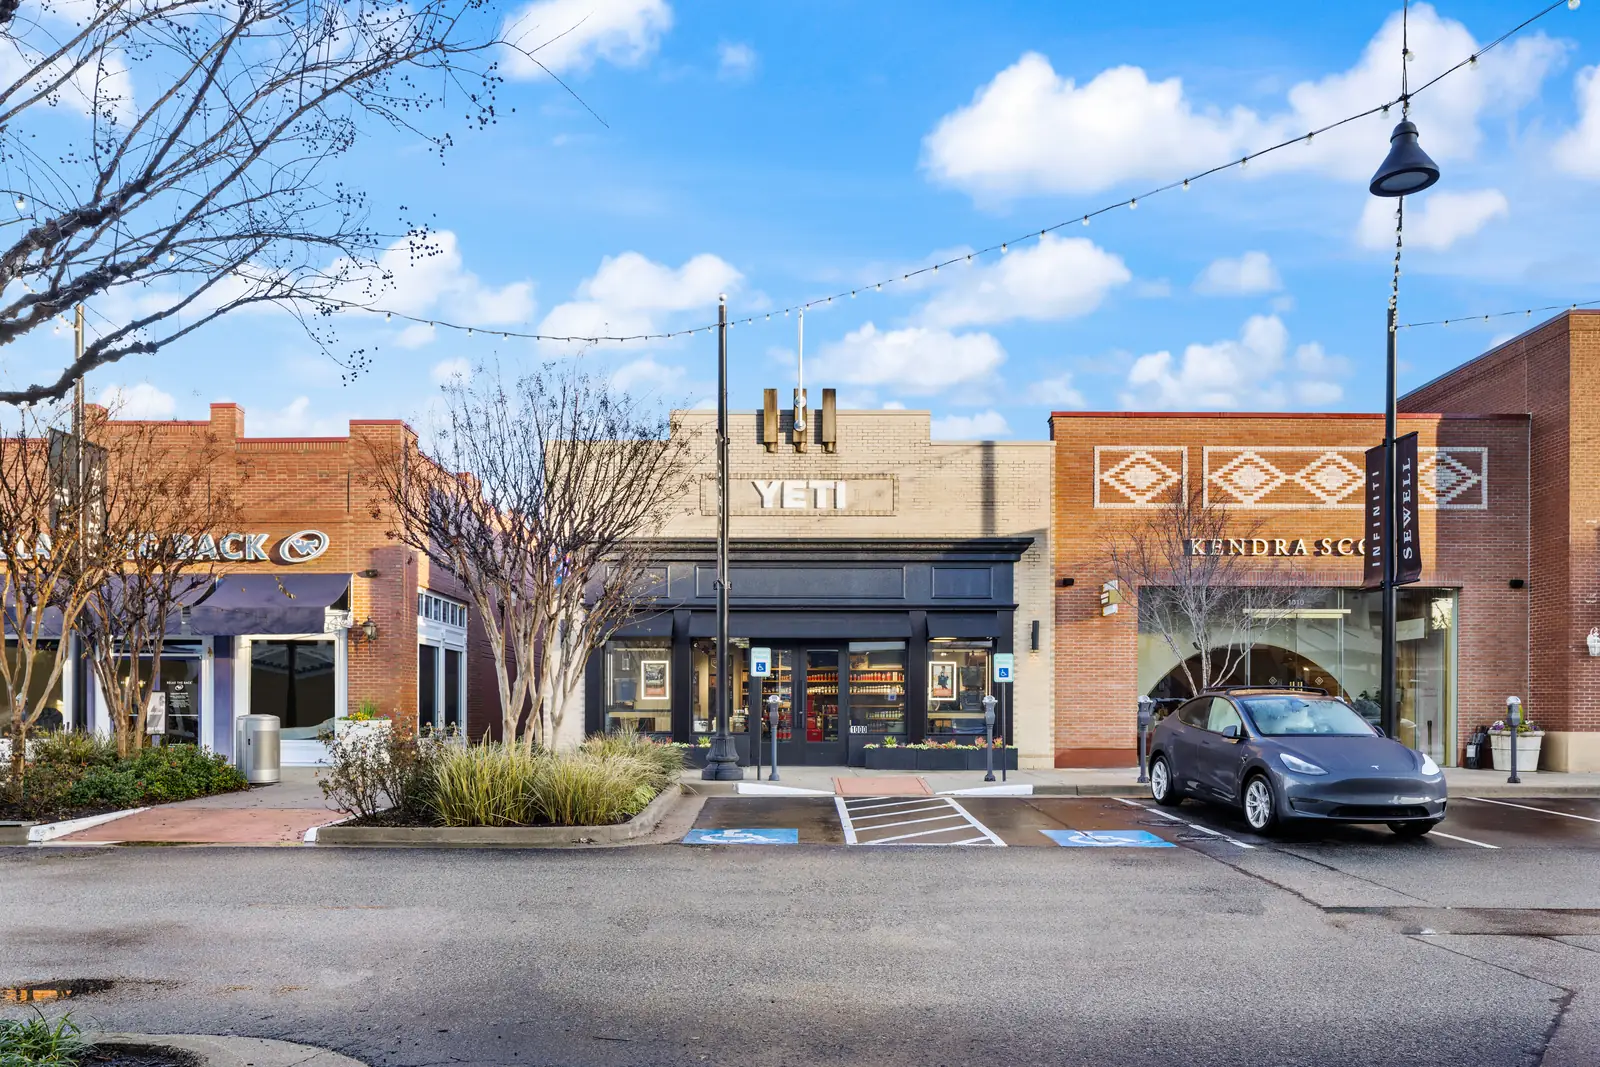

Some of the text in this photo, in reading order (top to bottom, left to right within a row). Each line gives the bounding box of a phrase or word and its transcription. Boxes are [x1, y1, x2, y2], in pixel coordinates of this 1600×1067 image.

[752, 480, 846, 509] YETI
[1402, 457, 1413, 560] SEWELL
[1372, 471, 1381, 567] INFINITI
[1190, 538, 1310, 556] KENDRA
[851, 725, 868, 734] 1000
